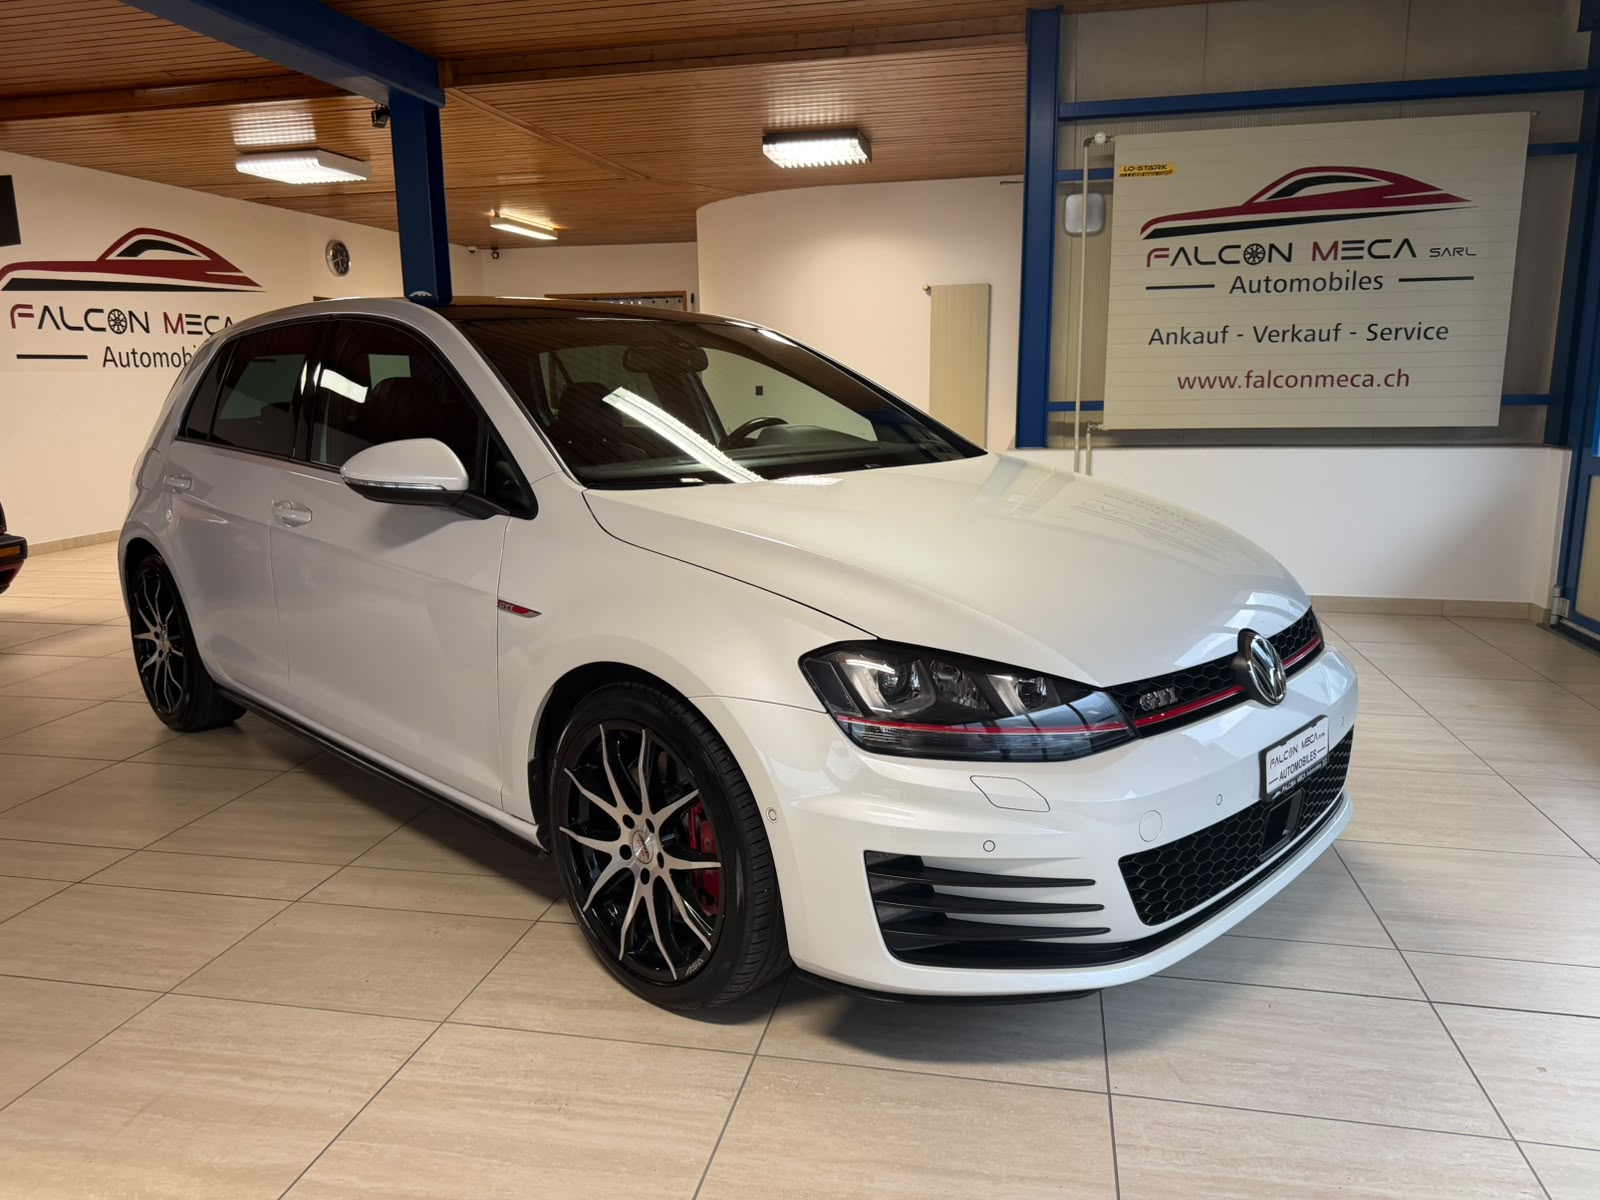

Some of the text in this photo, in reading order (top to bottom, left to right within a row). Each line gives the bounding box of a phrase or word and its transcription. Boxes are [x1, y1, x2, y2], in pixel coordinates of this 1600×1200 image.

[1147, 238, 1477, 268] FALCON MECA SARL
[1229, 270, 1384, 294] Automobiles
[10, 304, 150, 335] FALCON
[1148, 325, 1229, 346] Ankauf
[1252, 323, 1342, 344] Verkauf
[1366, 323, 1449, 342] Service
[1177, 368, 1410, 390] www.falconmeca.ch
[1270, 745, 1298, 769] FALCON
[1279, 749, 1317, 781] AUTOMOBILES
